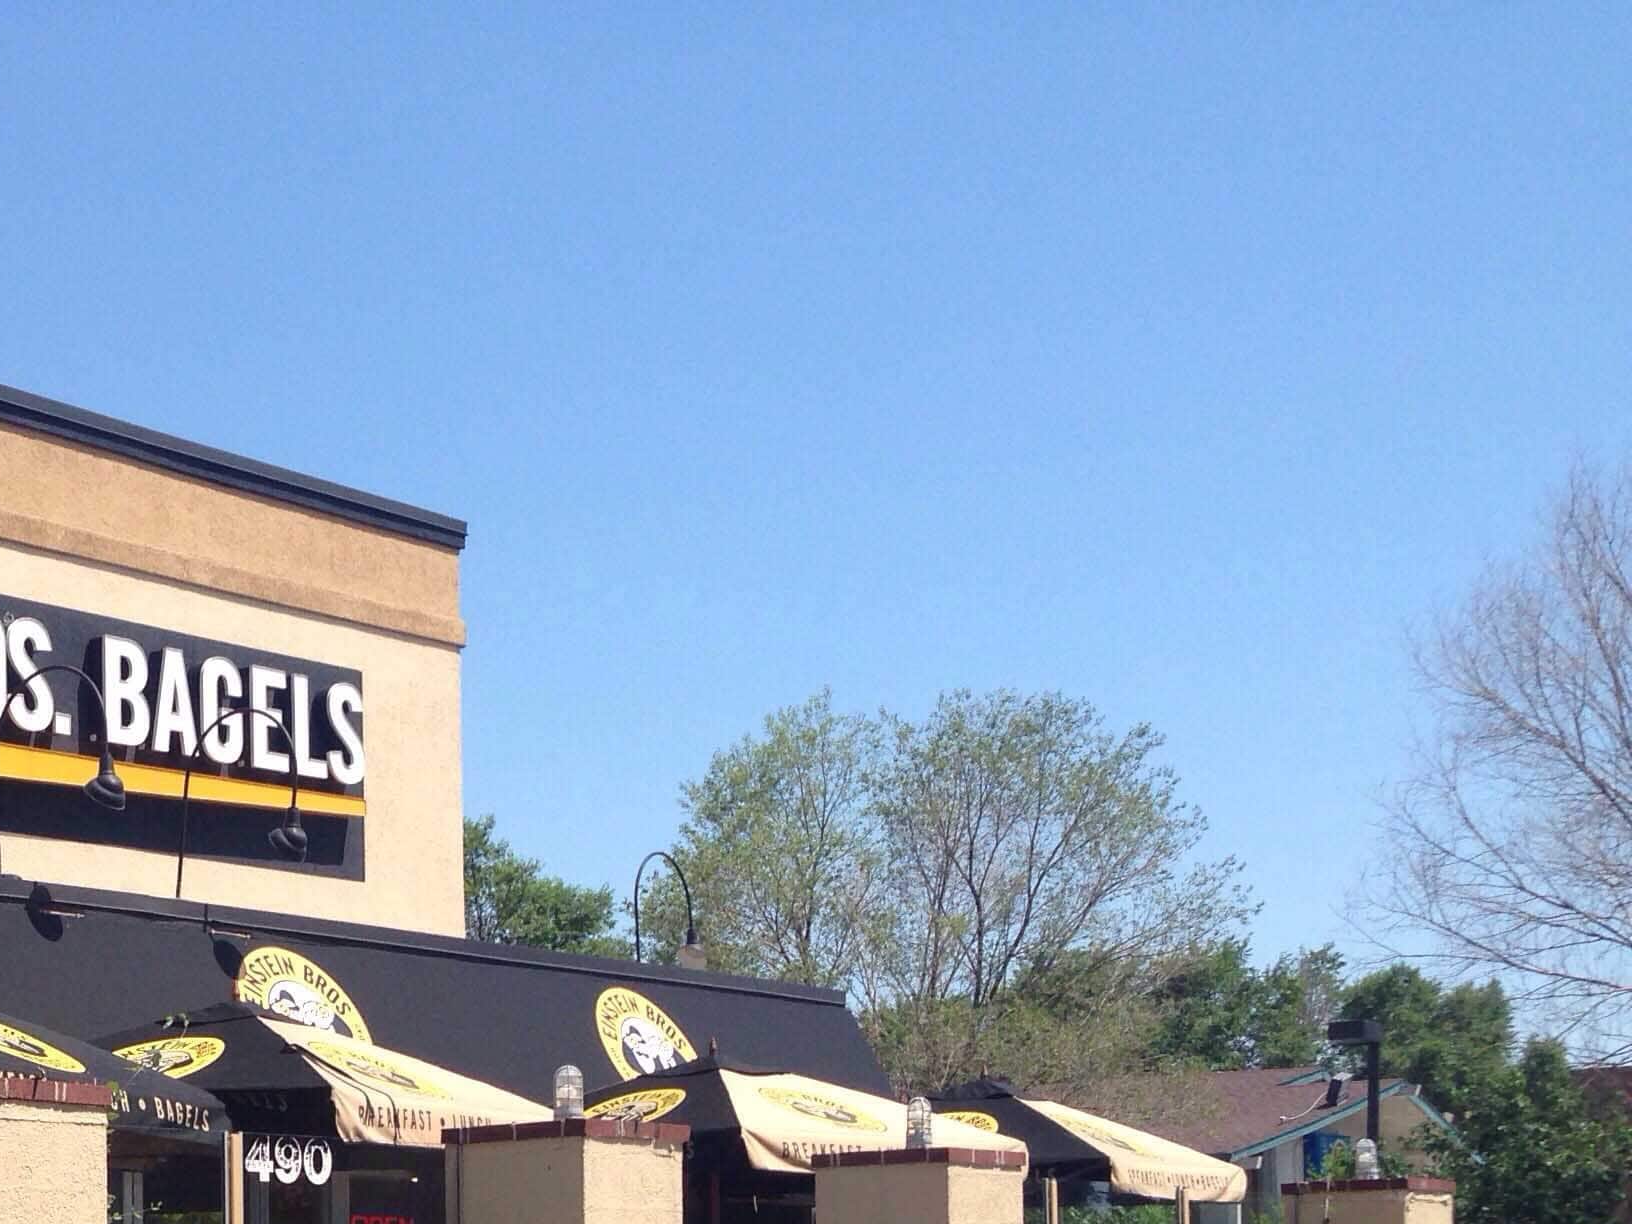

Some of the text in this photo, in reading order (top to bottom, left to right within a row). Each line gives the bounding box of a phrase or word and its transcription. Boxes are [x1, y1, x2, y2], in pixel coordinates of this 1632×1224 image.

[101, 633, 366, 786] BAGELS
[243, 953, 352, 1016] EINSTEIN BROS
[600, 993, 687, 1050] EINSTEIN BROS
[153, 1096, 210, 1133] BAGELS
[358, 1104, 432, 1132] BREAKFAST
[244, 1135, 333, 1186] 490
